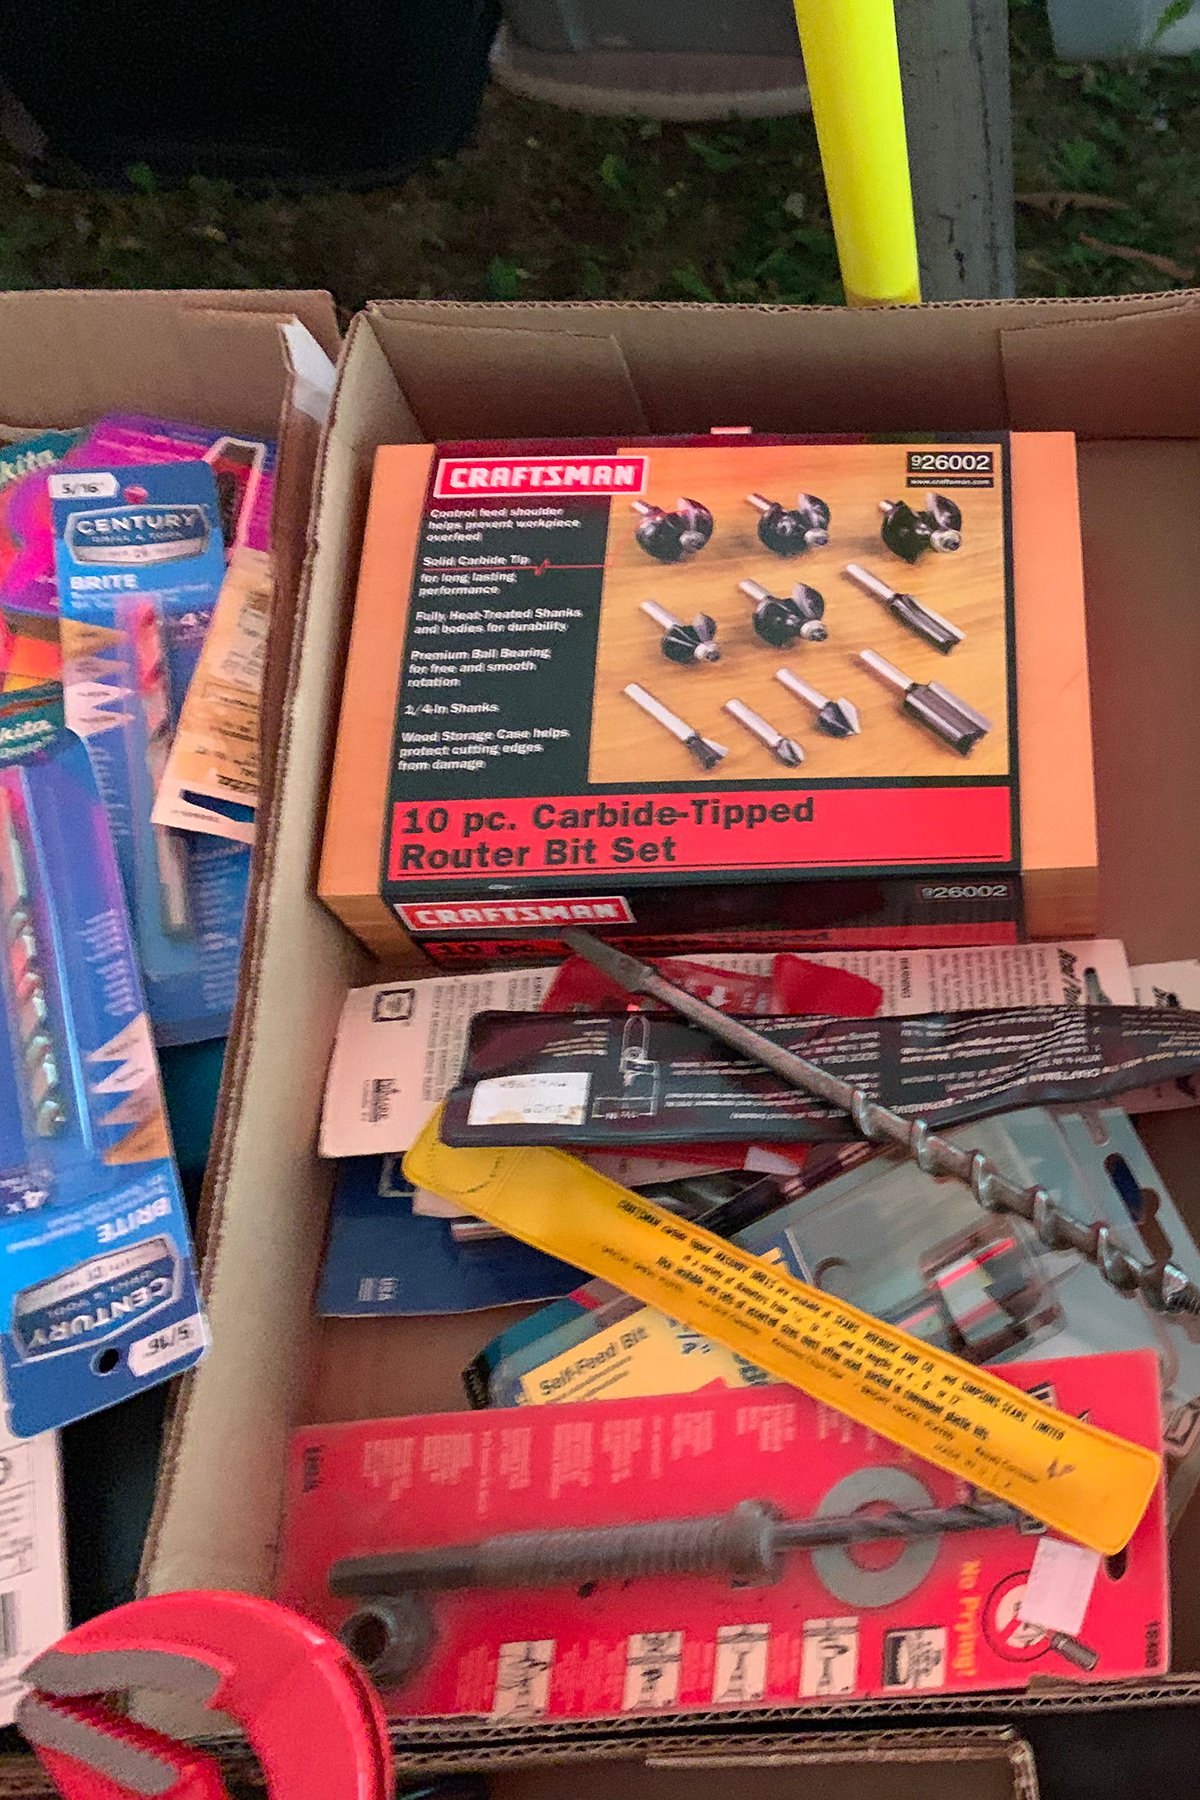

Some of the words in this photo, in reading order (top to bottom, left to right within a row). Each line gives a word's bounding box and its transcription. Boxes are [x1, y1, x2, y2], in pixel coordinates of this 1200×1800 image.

[911, 455, 991, 470] 926002
[450, 462, 641, 488] CRAFTSMAN
[430, 508, 477, 519] Control
[480, 507, 508, 518] feed
[509, 506, 563, 517] shoulder
[76, 512, 199, 534] CENTURY
[428, 520, 462, 532] helps
[465, 520, 514, 531] prevent
[516, 518, 581, 530] workpiece
[426, 532, 482, 543] overfeed
[423, 556, 456, 567] Solid
[458, 555, 507, 566] Carbide
[509, 554, 531, 566] Tip
[70, 574, 138, 591] BRITE
[420, 573, 437, 583] for
[441, 572, 470, 585] long
[472, 571, 517, 584] lasting
[418, 586, 500, 598] performance
[415, 611, 446, 623] Fully
[450, 609, 533, 621] Heat-Treated
[534, 608, 583, 619] Shanks
[414, 624, 439, 635] and
[441, 623, 484, 634] bodies
[487, 622, 505, 632] for
[507, 621, 568, 633] durability
[411, 650, 469, 661] Premium
[471, 649, 499, 659] Ball
[500, 648, 552, 660] Bearing
[409, 664, 427, 674] for
[430, 663, 457, 674] free
[459, 662, 485, 673] and
[487, 661, 537, 672] smooth
[407, 677, 461, 688] rotation
[450, 702, 500, 714] Shanks
[401, 731, 440, 743] Wood
[441, 730, 495, 742] Storage
[496, 728, 531, 740] Case
[533, 728, 571, 740] helps
[399, 745, 450, 758] protect
[451, 744, 500, 756] cutting
[502, 742, 544, 755] edges
[398, 760, 431, 771] from
[432, 758, 487, 771] damage
[402, 806, 449, 835] 10
[462, 807, 518, 838] pc.
[533, 795, 814, 832] Carbide-Tipped
[400, 841, 530, 872] Router
[544, 837, 598, 867] Bit
[610, 834, 677, 864] Set
[921, 884, 1009, 900] 926002
[414, 902, 620, 925] CRAFTSMAN
[96, 1197, 172, 1244] BRITE
[28, 1277, 174, 1349] CENTURY
[616, 1198, 662, 1229] CRAFTSMAN
[712, 1249, 750, 1275] MASONRY
[749, 1269, 776, 1289] DRILLS
[862, 1329, 900, 1355] ROEBUCK
[899, 1349, 919, 1366] AND
[1031, 1417, 1065, 1442] LIMITED
[698, 1262, 724, 1282] variety
[733, 1280, 769, 1305] diameters
[769, 1299, 789, 1316] from
[863, 1349, 893, 1373] lengths
[538, 1341, 616, 1397] Self-Feed
[620, 1326, 649, 1350] Bit
[902, 1387, 944, 1417] convenient
[942, 1409, 972, 1433] plastic
